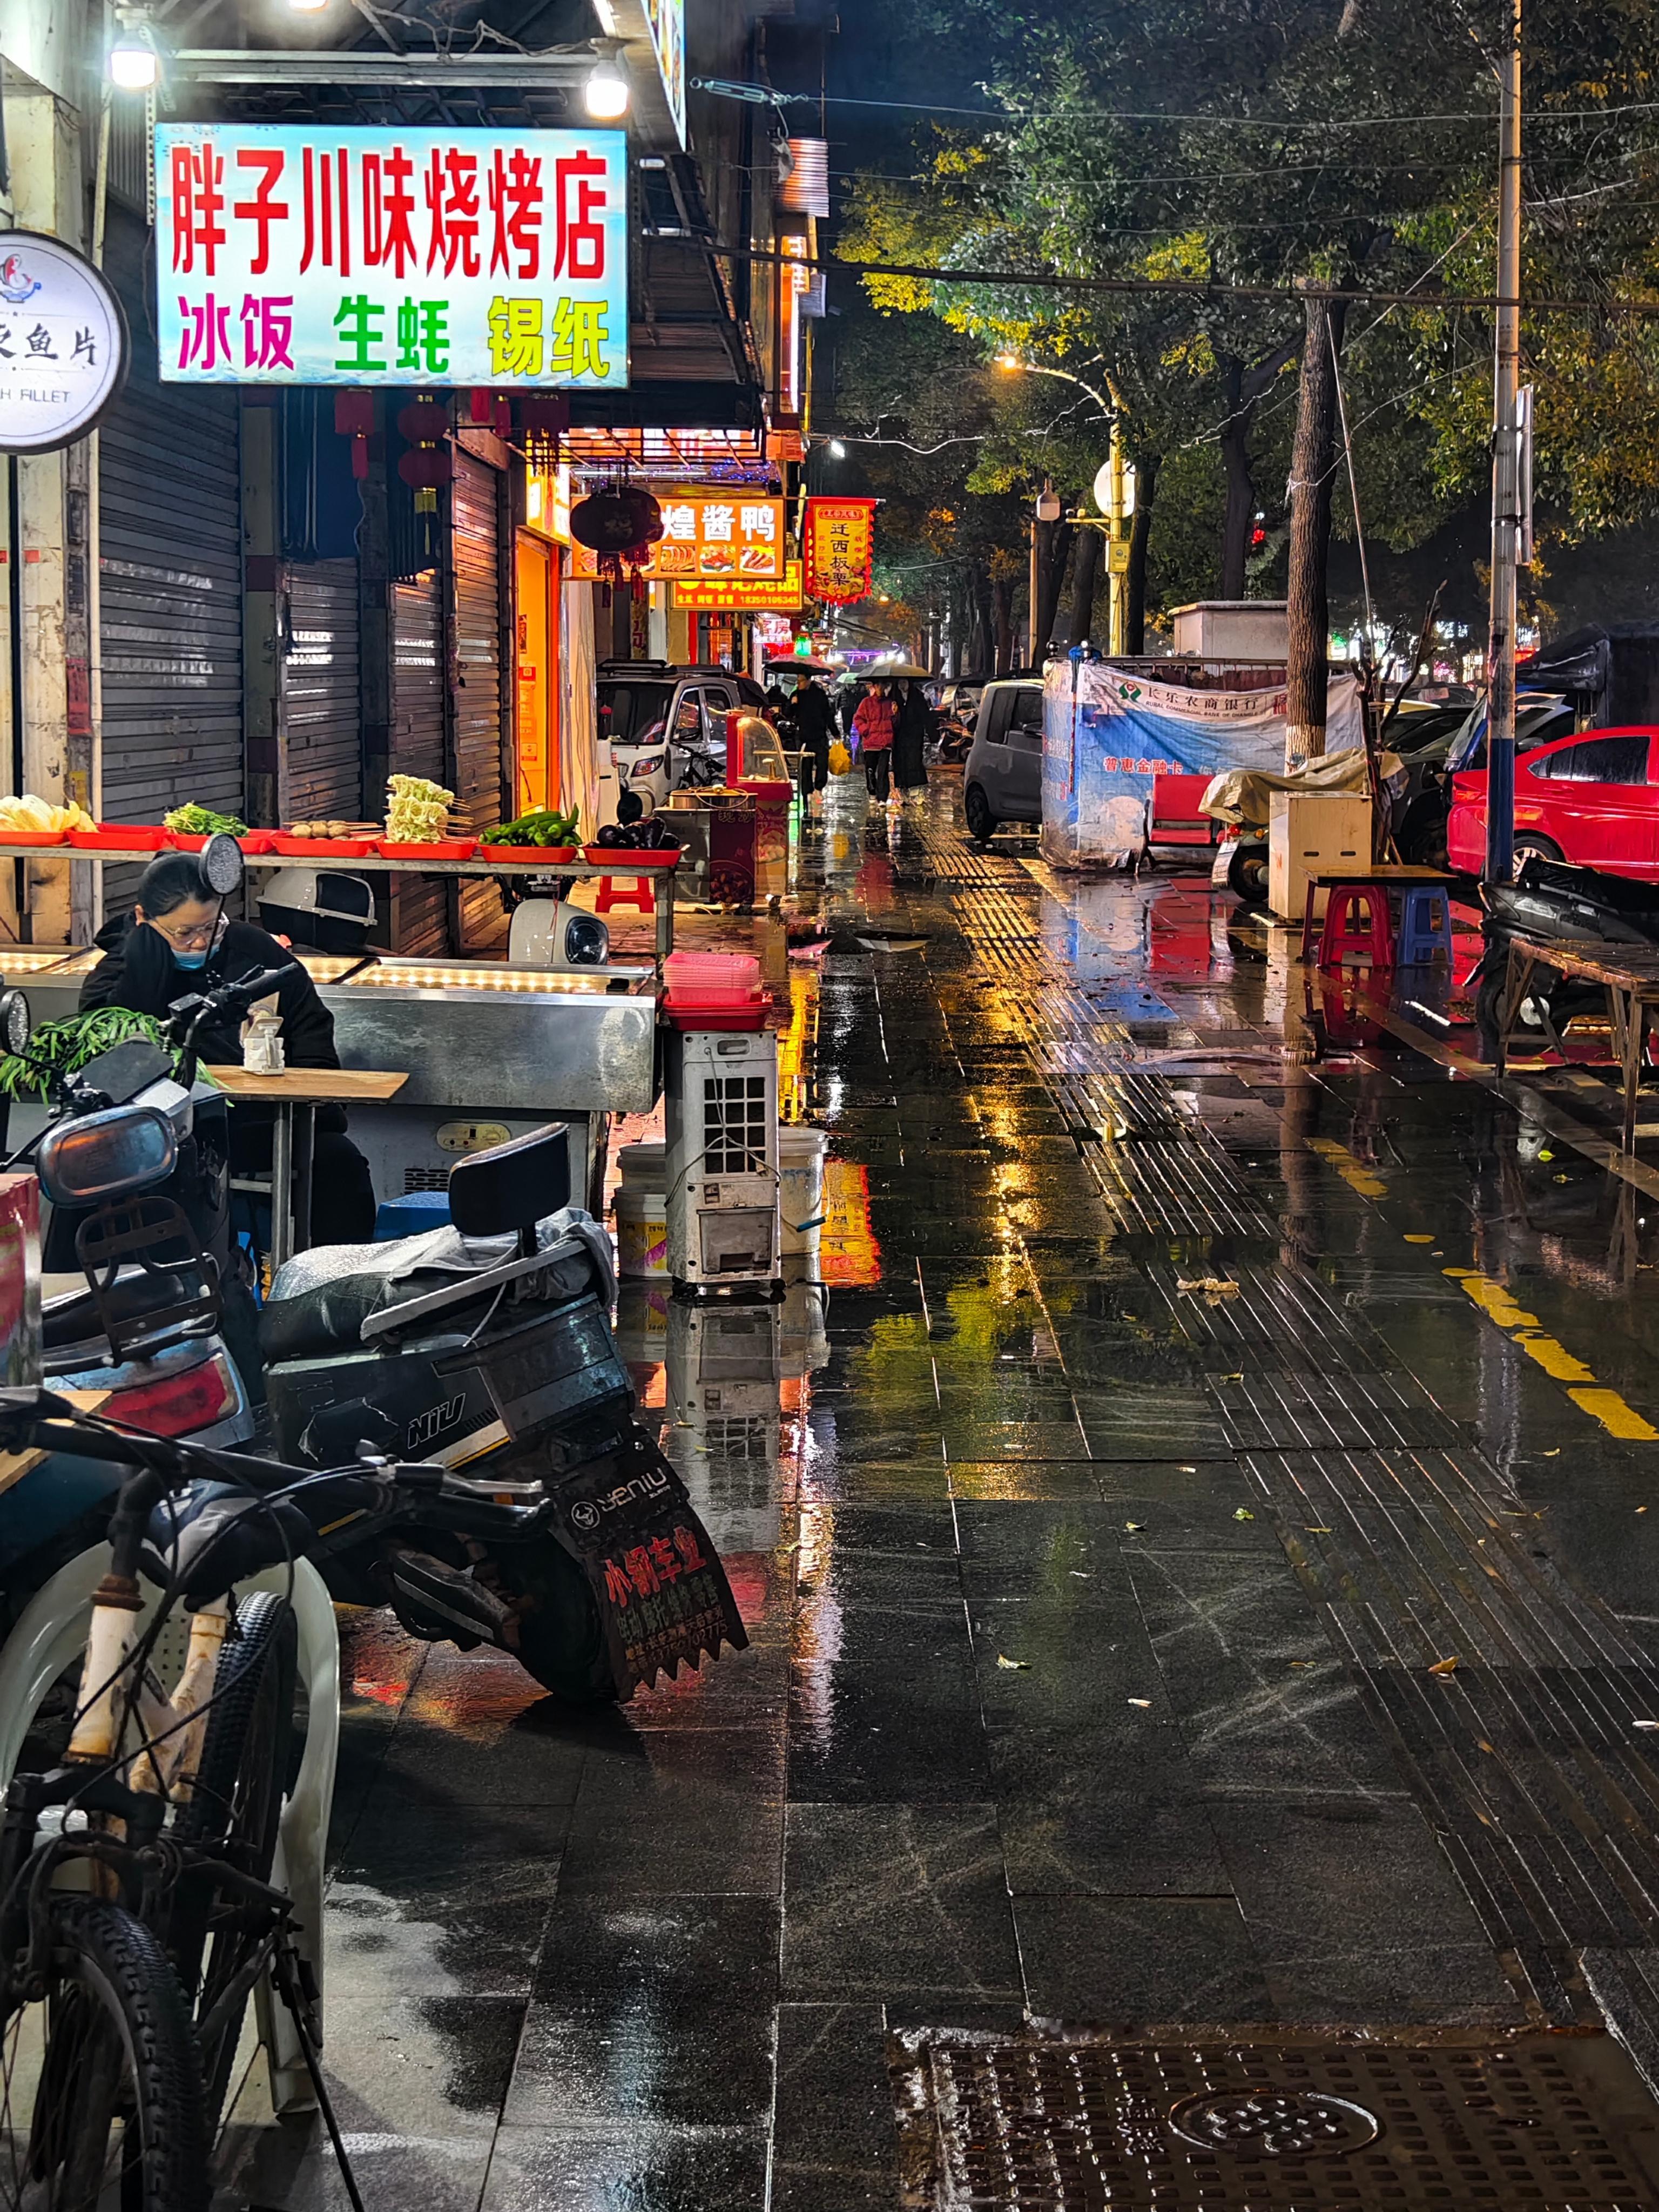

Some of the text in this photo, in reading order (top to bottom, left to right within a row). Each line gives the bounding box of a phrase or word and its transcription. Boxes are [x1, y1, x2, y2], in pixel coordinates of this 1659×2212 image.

[172, 143, 606, 281] 胖子川味烧烤店
[177, 293, 610, 378] 冰饭 生蚝 锡纸
[20, 388, 71, 404] FILLET
[660, 504, 775, 542] 煌酱鸭
[830, 523, 851, 586] 迁西板栗
[1148, 687, 1259, 711] 长乐农商银行
[1165, 704, 1202, 716] COMMERCIAL
[1103, 757, 1183, 775] 普惠金融卡
[407, 1392, 466, 1449] NIU
